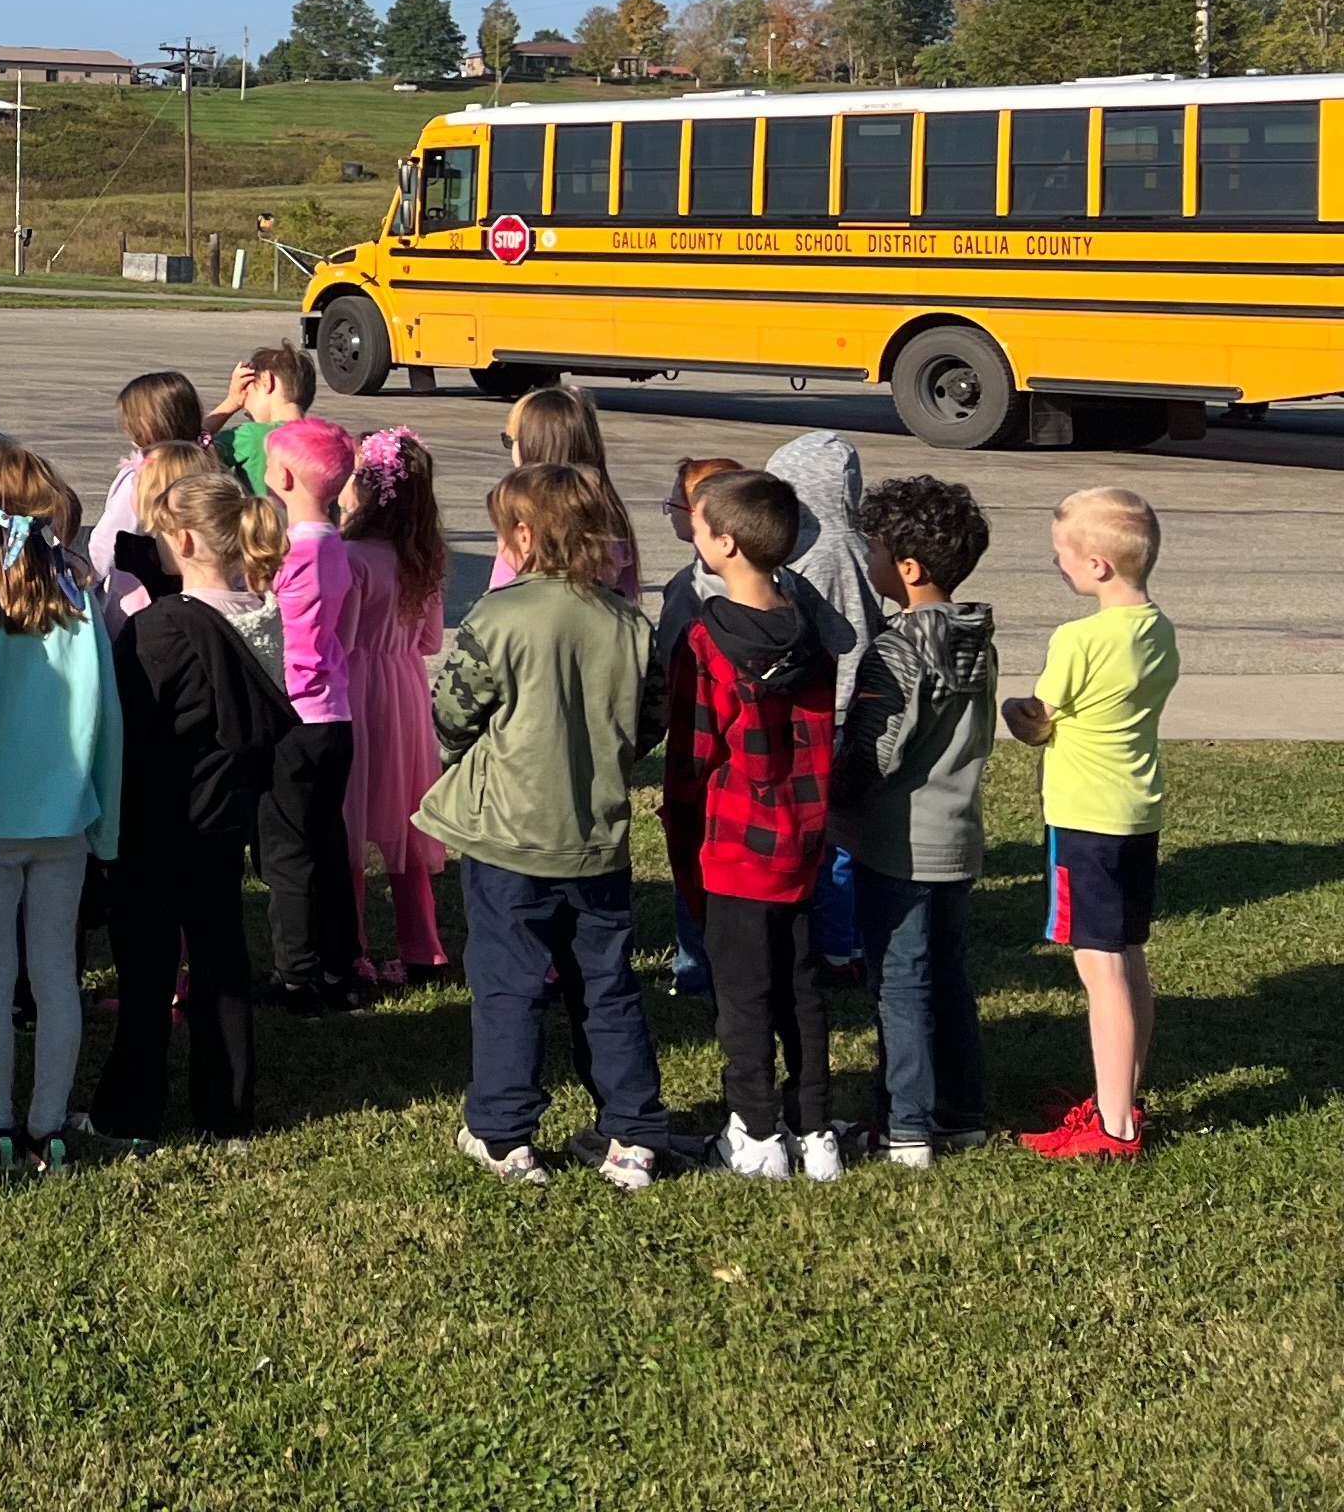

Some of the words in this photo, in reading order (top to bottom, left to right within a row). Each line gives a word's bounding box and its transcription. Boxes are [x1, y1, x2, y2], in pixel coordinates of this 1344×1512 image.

[494, 229, 525, 250] STOP
[612, 231, 657, 250] GALLIA
[670, 232, 723, 251] COUNTY
[737, 232, 781, 252] LOCAL
[795, 233, 853, 253] SCHOOL
[868, 234, 937, 253] DISTRICT
[953, 235, 1010, 255] GALLIA
[1026, 235, 1093, 257] COUNTY
